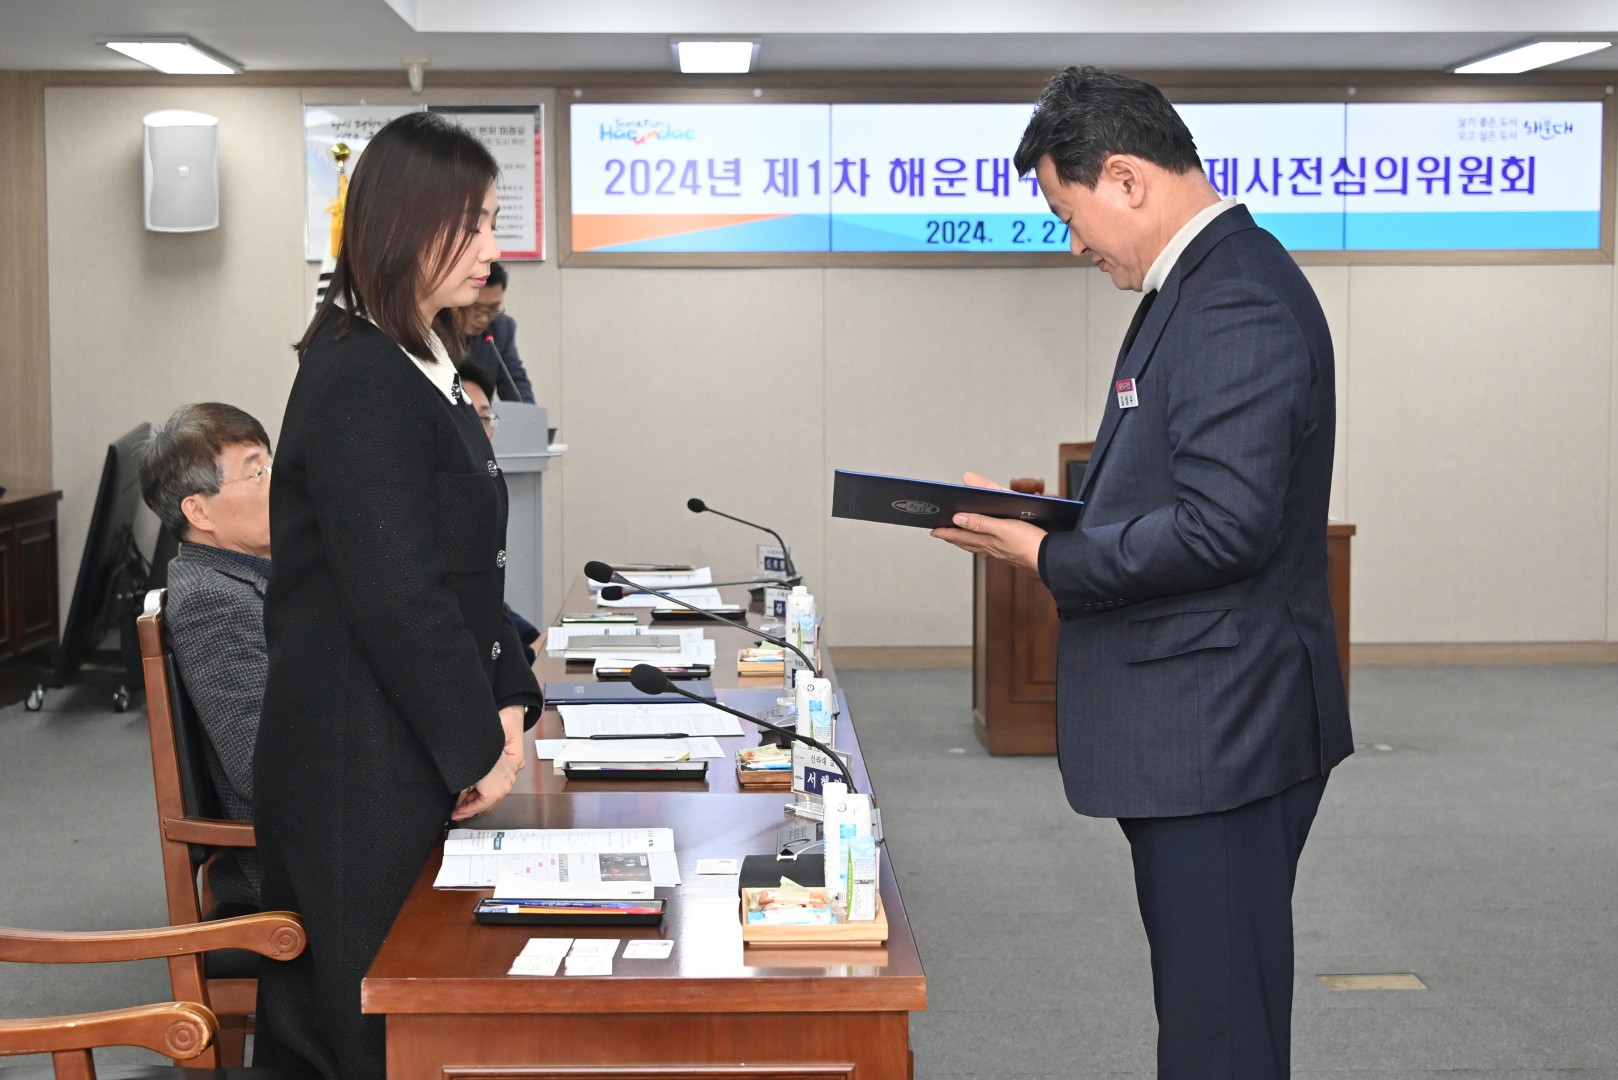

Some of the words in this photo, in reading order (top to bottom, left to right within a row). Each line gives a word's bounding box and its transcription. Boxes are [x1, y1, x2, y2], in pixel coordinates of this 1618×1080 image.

[604, 157, 742, 198] 2024년
[763, 157, 871, 198] 제1차
[889, 157, 1038, 198] 해운대
[1203, 155, 1537, 197] 제사전심의위원회
[926, 220, 993, 244] 2024.
[1011, 220, 1032, 244] 2.
[1042, 220, 1069, 244] 27
